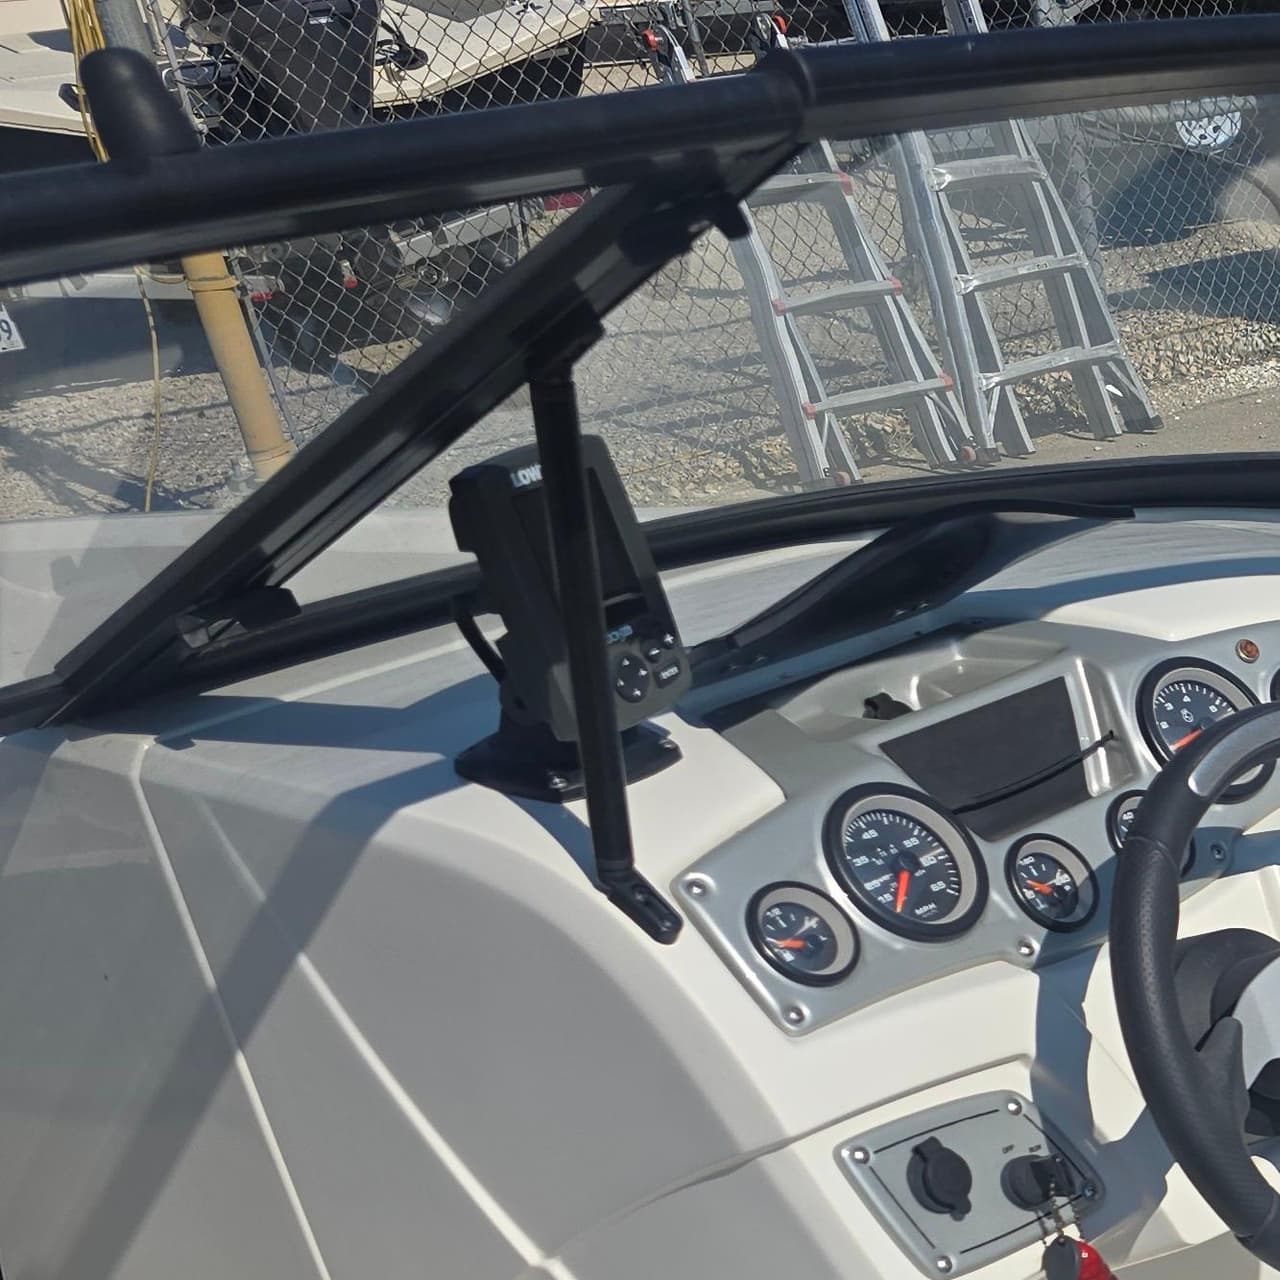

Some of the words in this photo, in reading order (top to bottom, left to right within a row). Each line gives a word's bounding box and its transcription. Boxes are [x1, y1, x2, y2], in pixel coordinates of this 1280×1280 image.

[862, 829, 879, 839] 45
[853, 856, 869, 866] 35
[878, 893, 894, 903] 15
